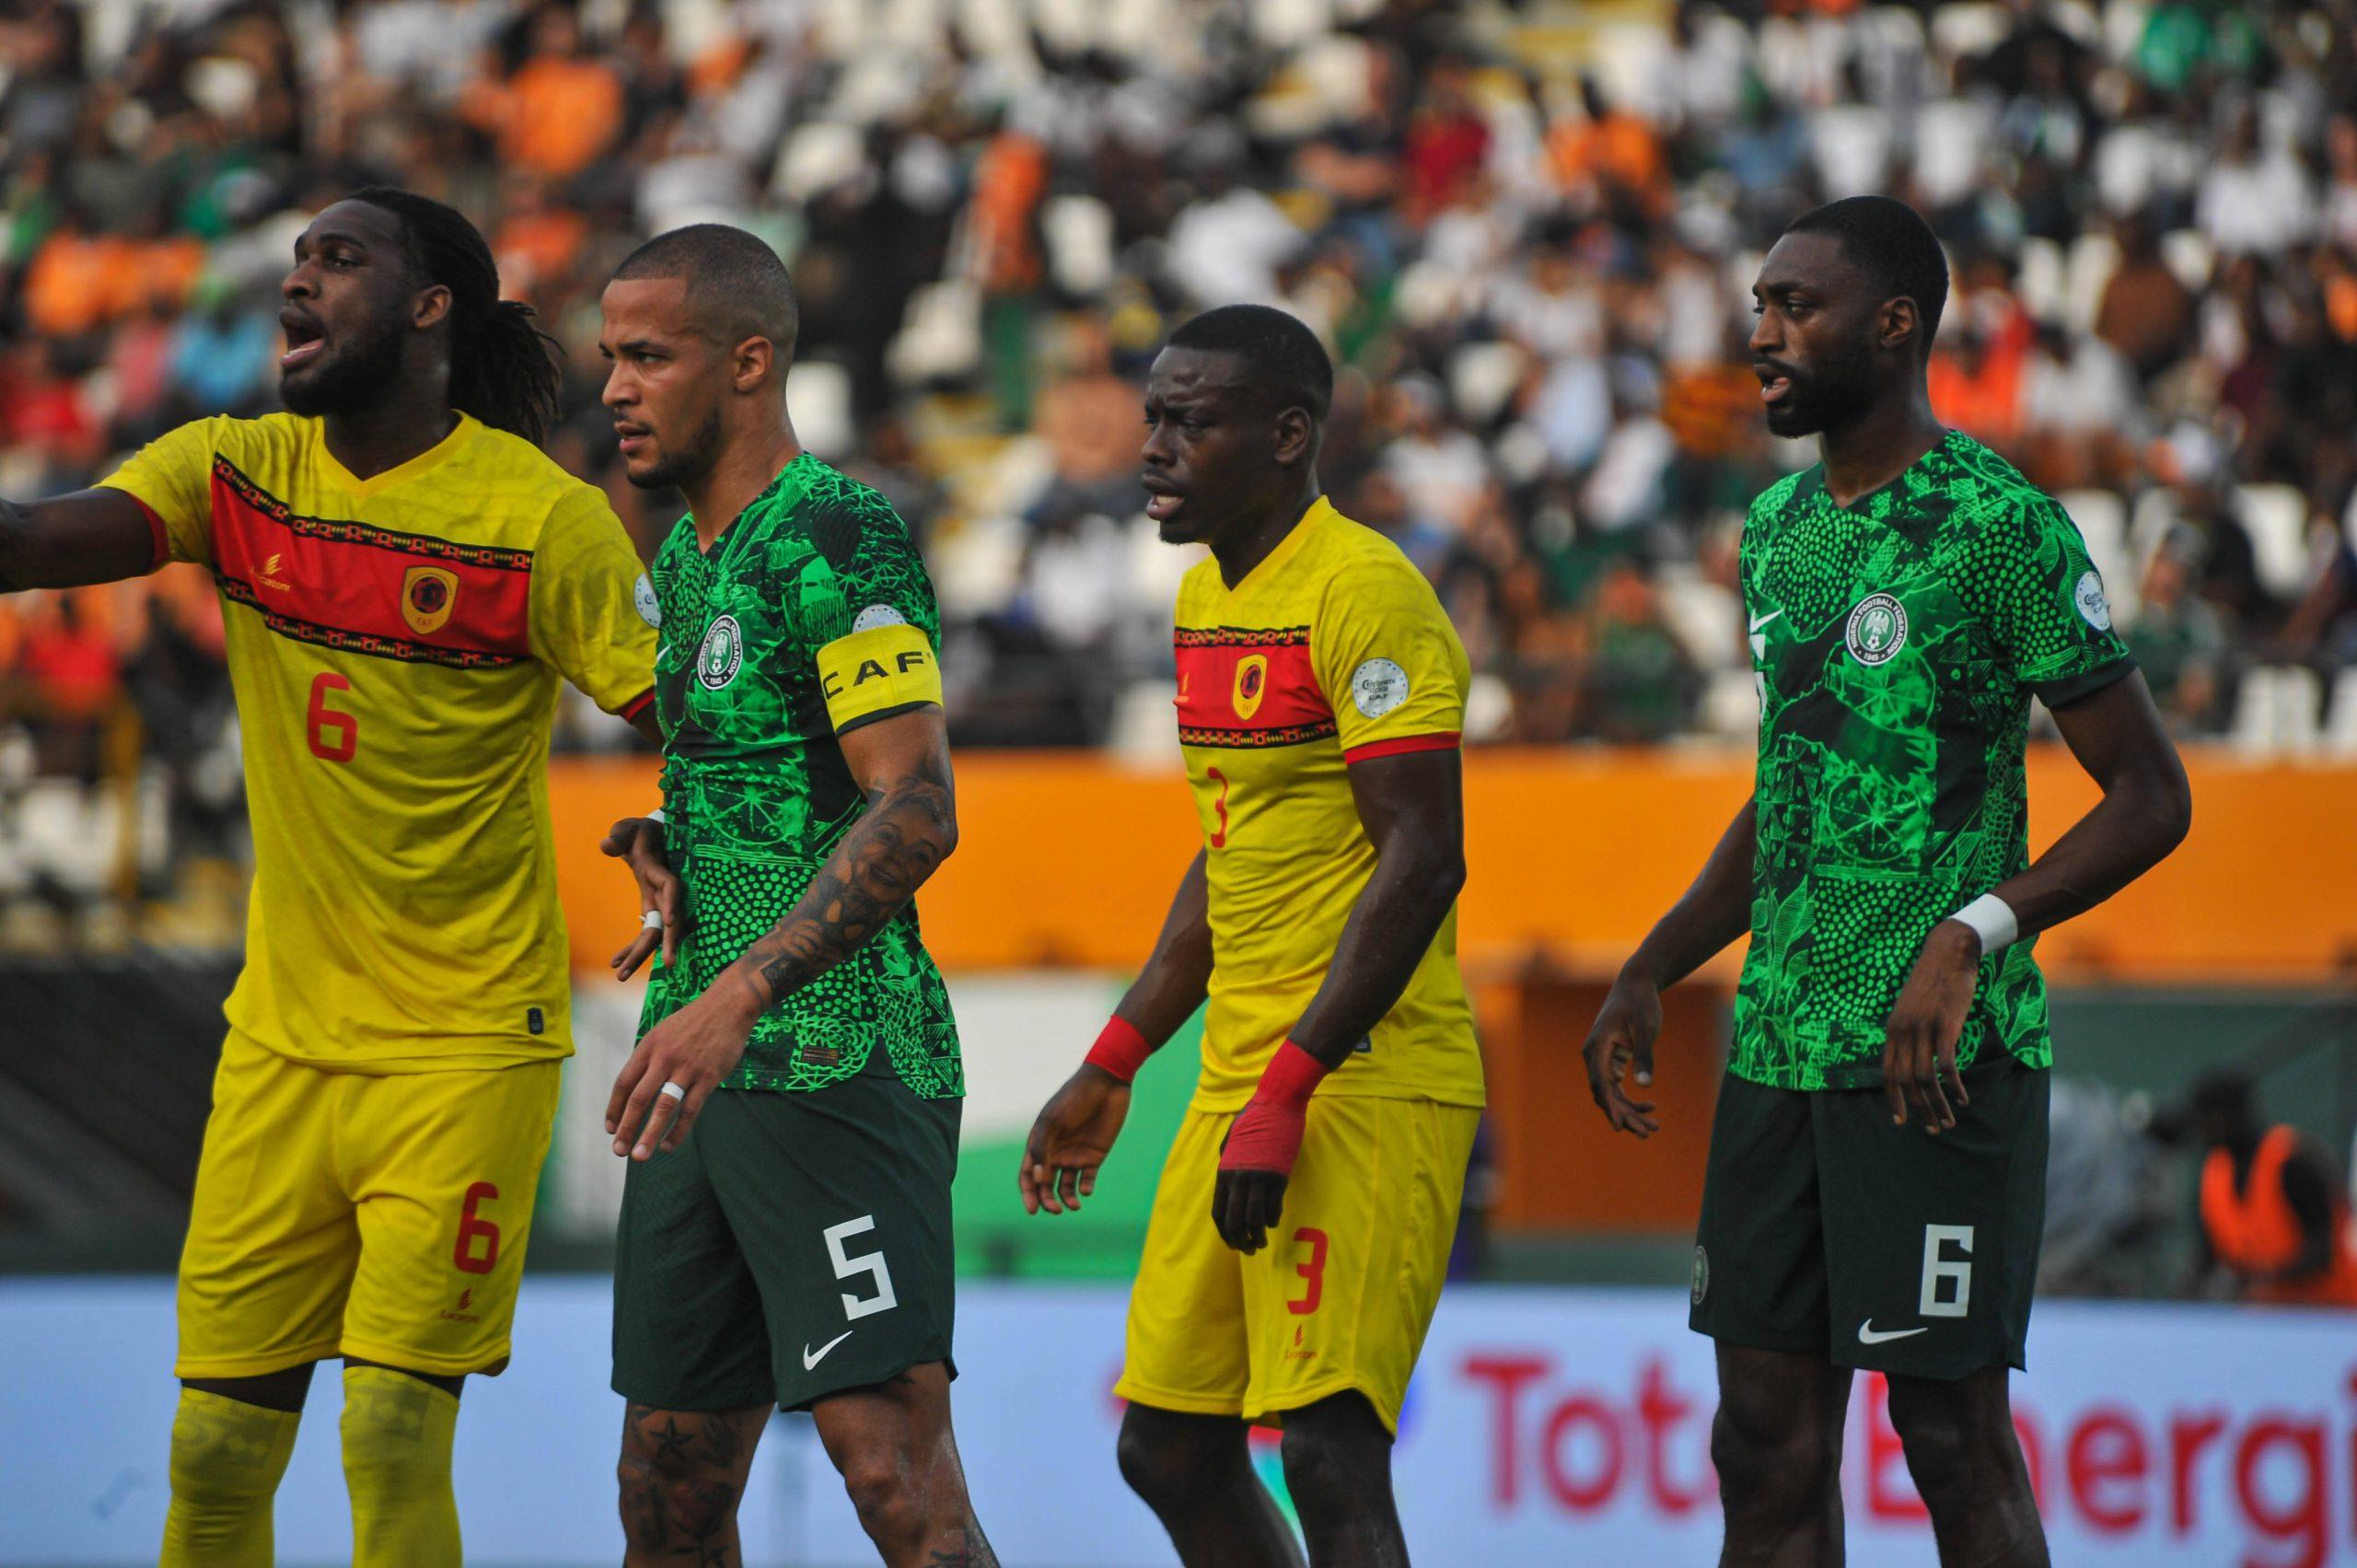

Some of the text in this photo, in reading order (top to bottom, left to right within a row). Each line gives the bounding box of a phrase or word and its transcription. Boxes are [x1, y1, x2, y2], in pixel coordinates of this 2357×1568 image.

[1858, 598, 1893, 615] FOOTBALL
[1887, 605, 1906, 655] FEDERATION
[307, 672, 358, 763] 6
[822, 651, 924, 700] CAF
[1207, 766, 1228, 848] 3
[453, 1181, 500, 1274] 6
[823, 1214, 898, 1320] 5
[1286, 1227, 1329, 1315] 3
[1920, 1224, 1974, 1318] 6
